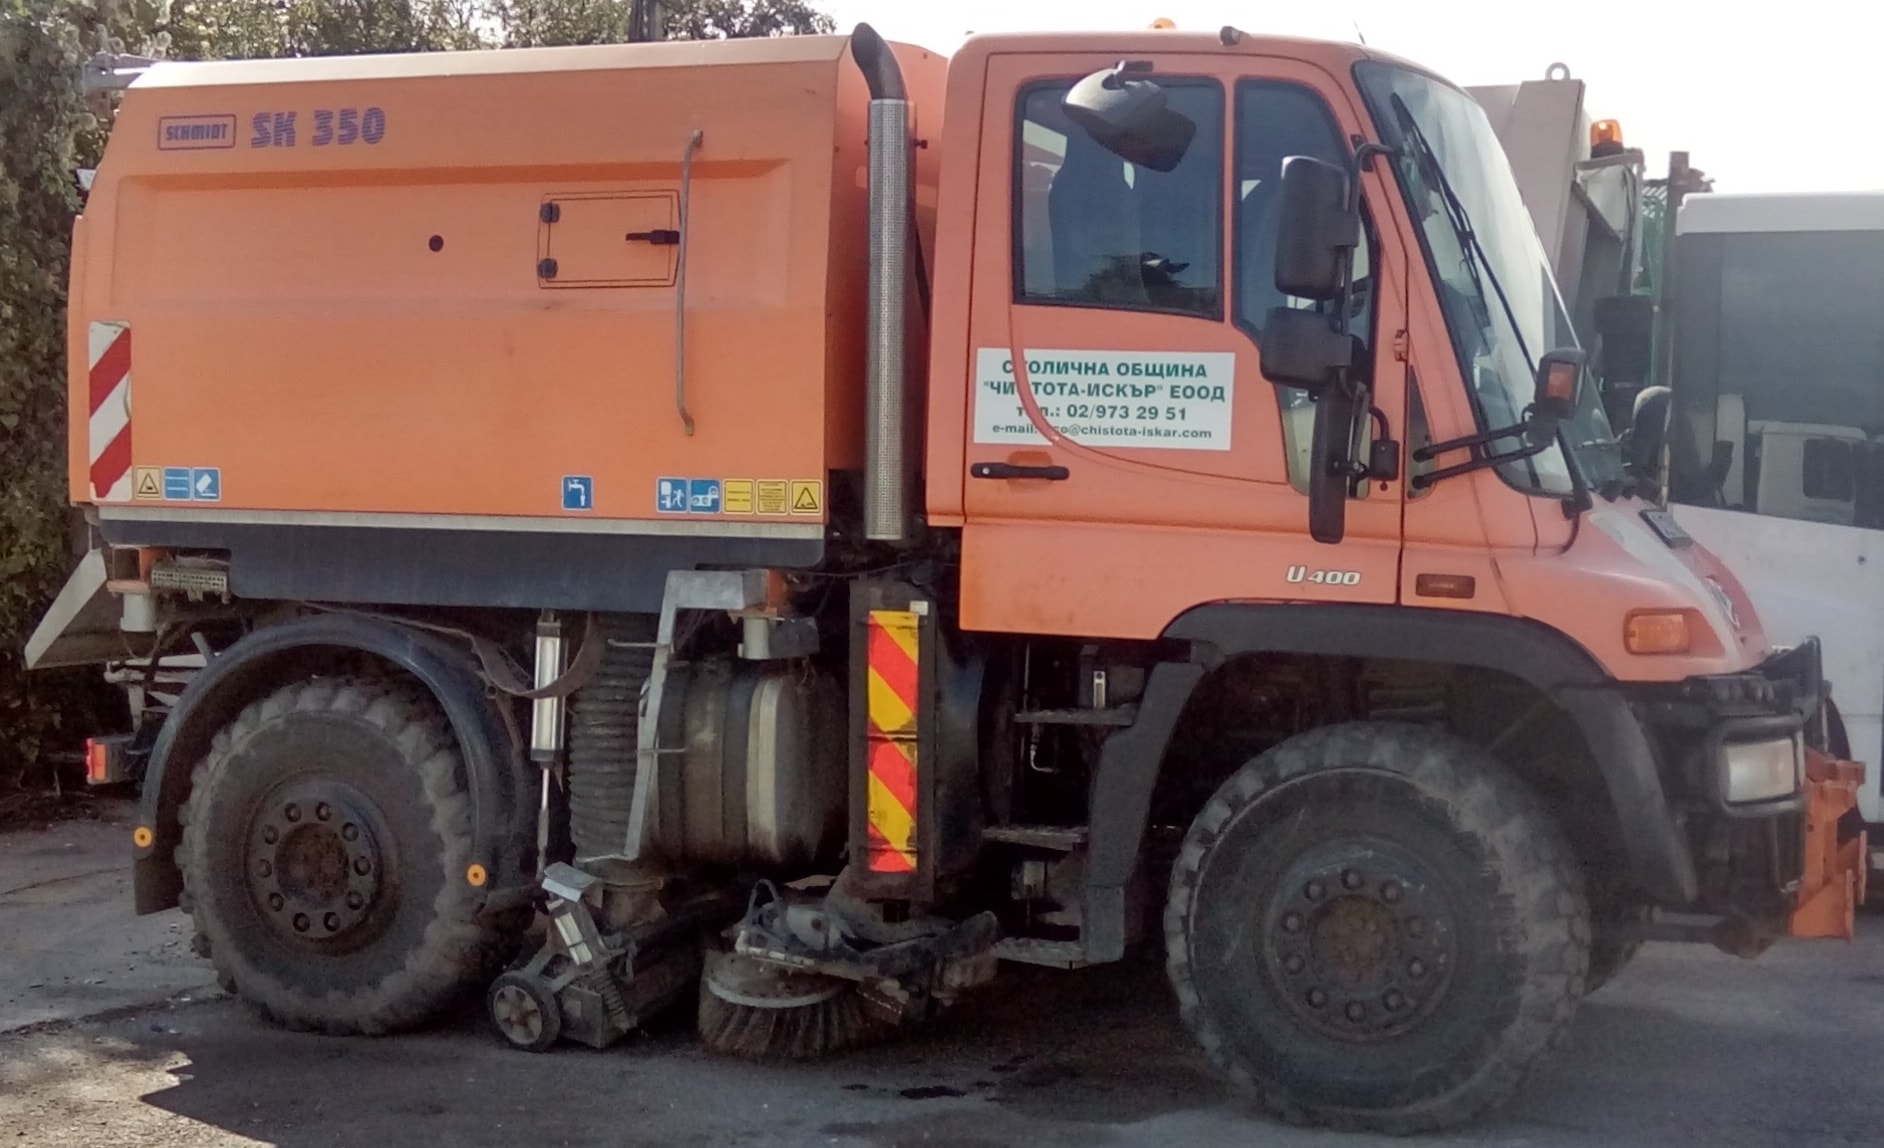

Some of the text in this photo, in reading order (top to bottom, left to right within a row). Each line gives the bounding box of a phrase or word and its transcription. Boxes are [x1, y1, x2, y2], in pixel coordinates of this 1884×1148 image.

[165, 123, 228, 141] SCHMIDT
[251, 107, 386, 148] SK 350
[1002, 360, 1207, 379] СОЛИЧНА ОБЩИНА
[983, 381, 1226, 402] "ЧИТОТА-ИСКЪР" ЕООД
[1016, 404, 1186, 421] тл.: 02/973 29 51
[1049, 424, 1212, 438] o@chistota-iskar.com
